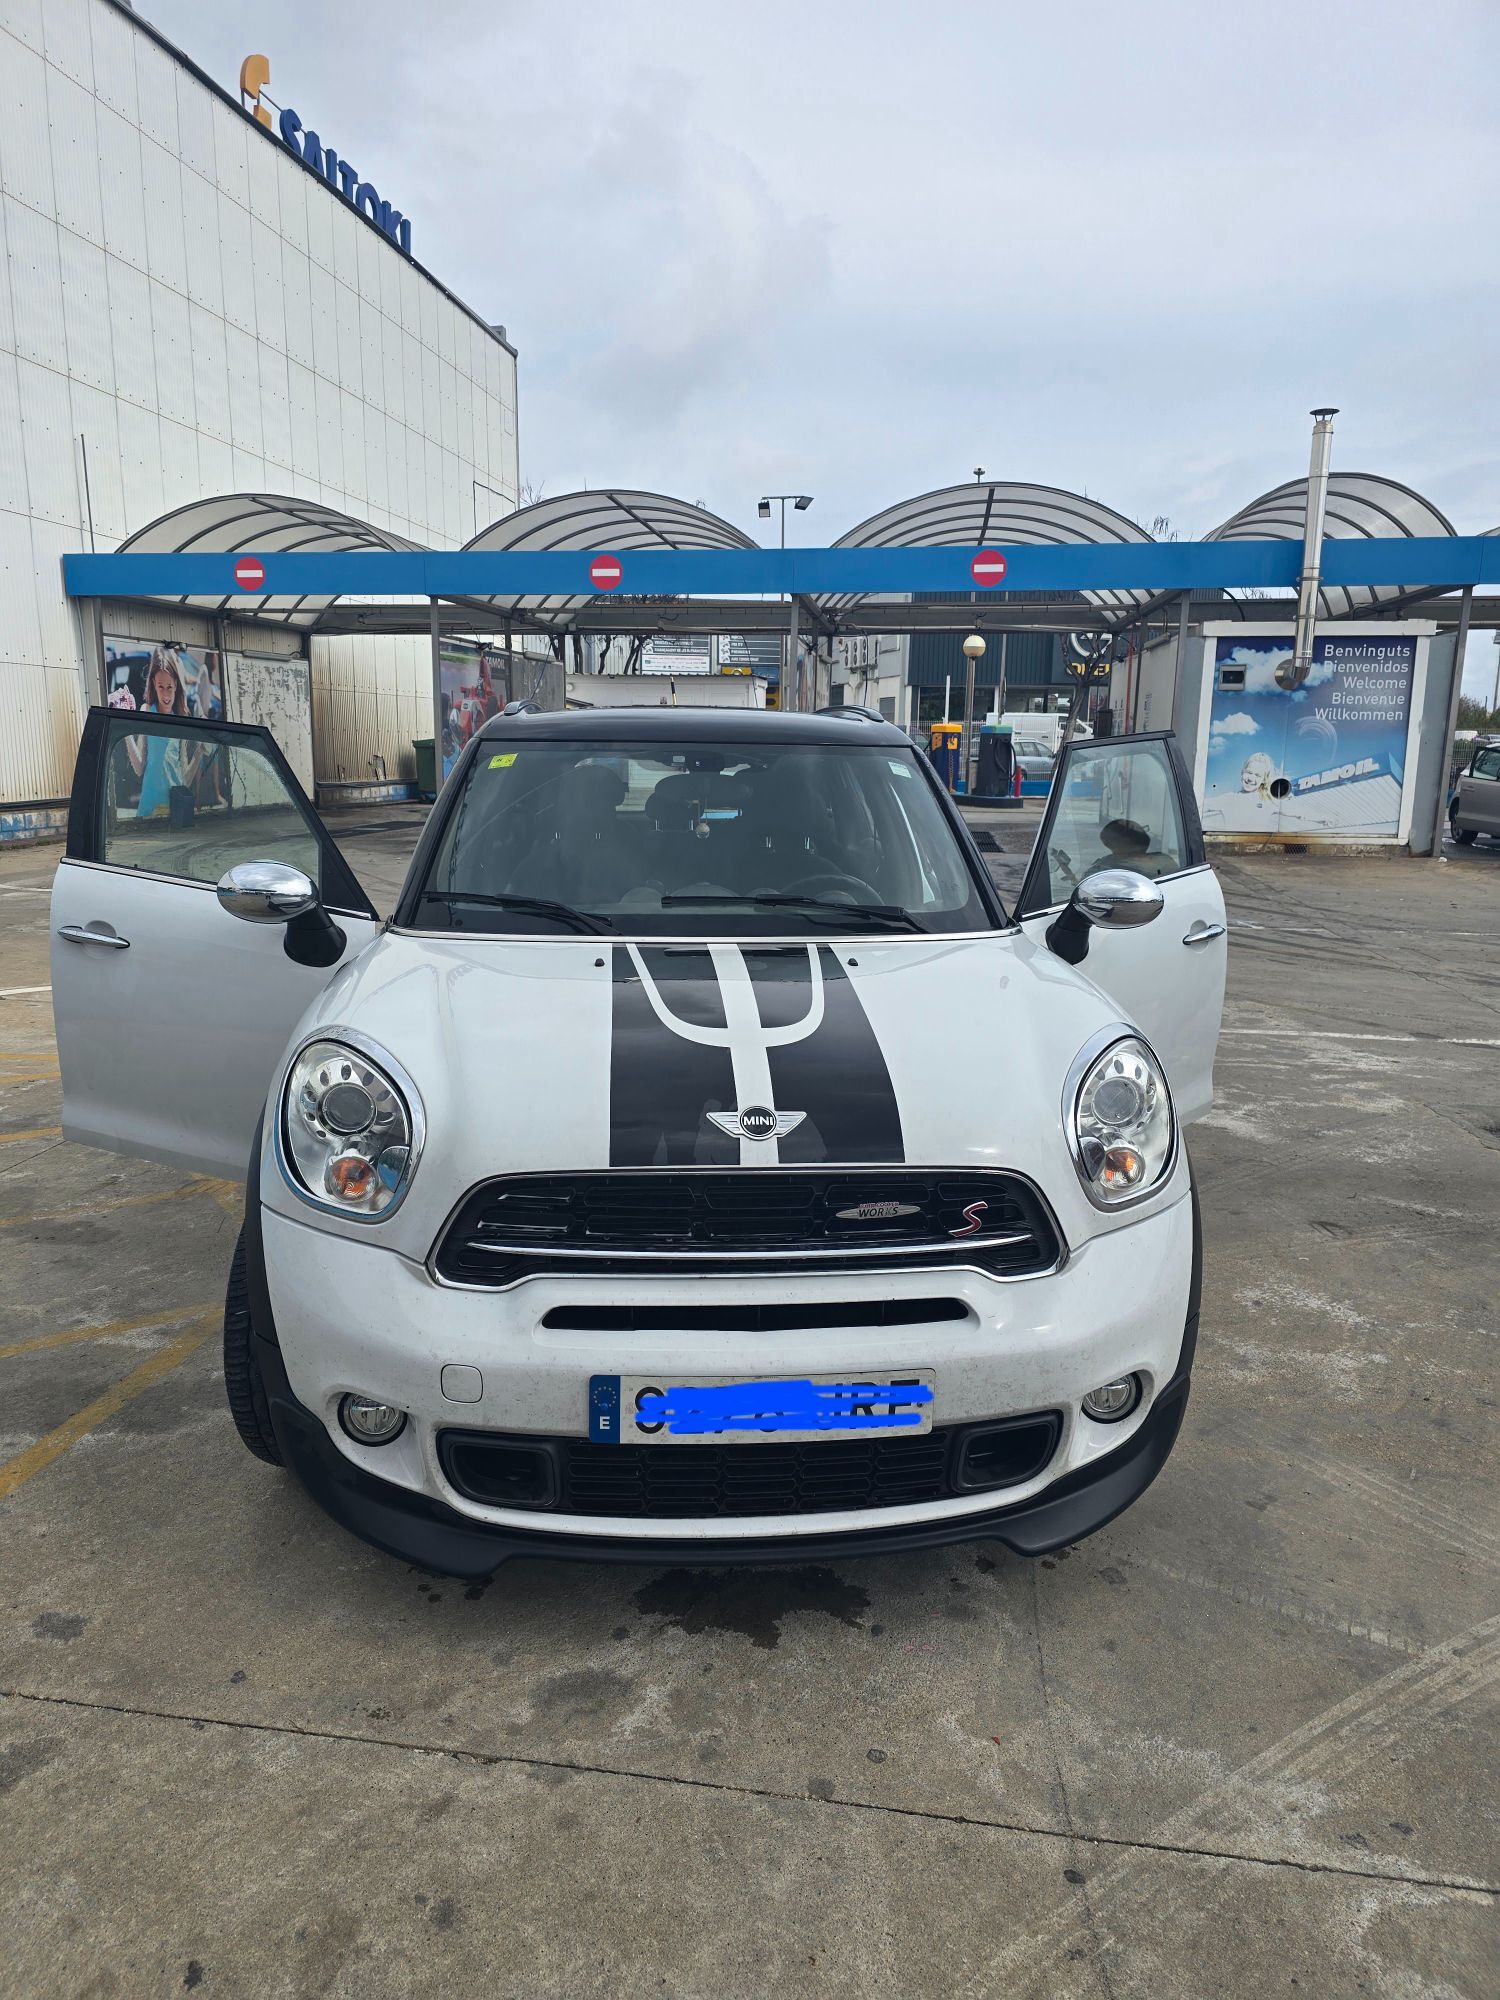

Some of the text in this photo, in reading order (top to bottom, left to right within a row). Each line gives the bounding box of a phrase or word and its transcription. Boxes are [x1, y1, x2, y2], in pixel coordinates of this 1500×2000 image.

[280, 108, 412, 256] SAITOKI
[1324, 644, 1411, 660] Benvinguts
[1323, 660, 1409, 673] Bienvenidos
[1343, 676, 1407, 689] Welcome
[1331, 691, 1405, 705] Bienvenue
[1314, 707, 1404, 721] Willkommen
[743, 1116, 774, 1126] MINI
[948, 1200, 989, 1238] S
[599, 1415, 611, 1430] E
